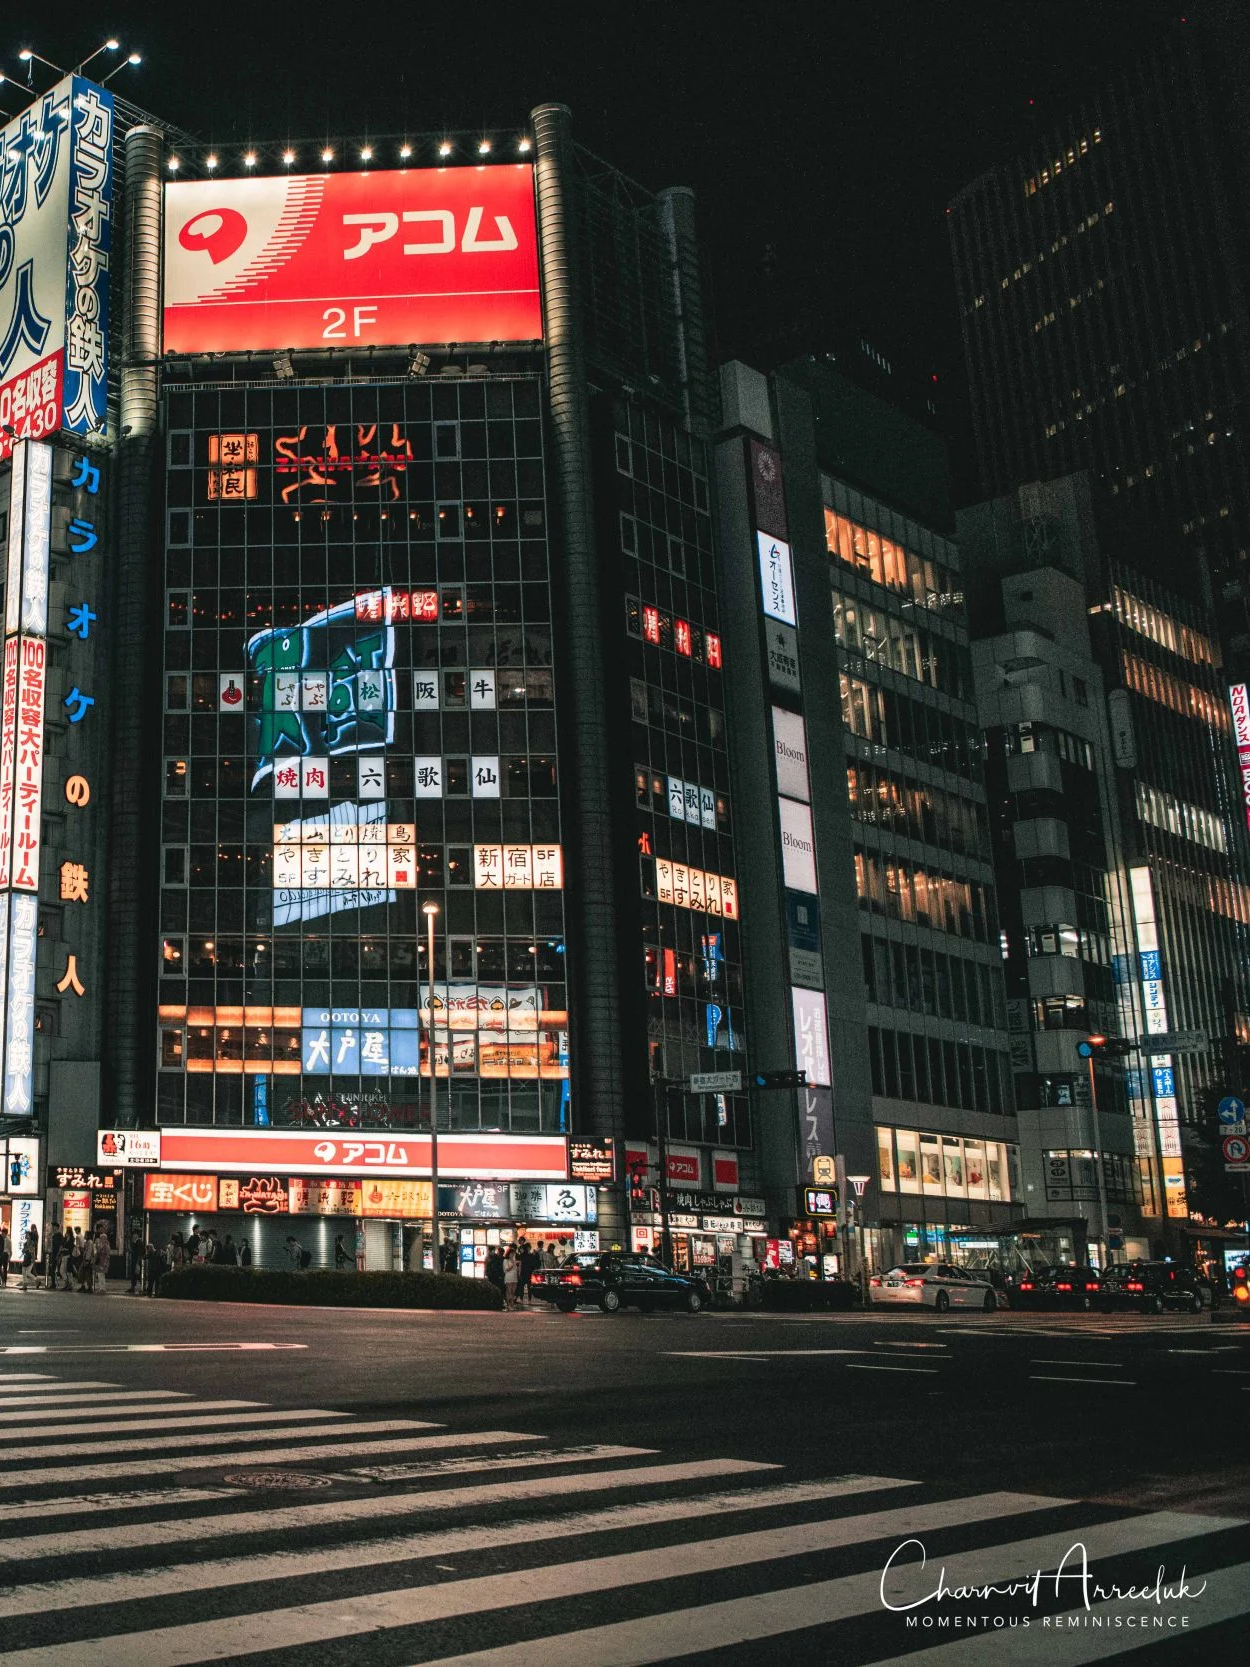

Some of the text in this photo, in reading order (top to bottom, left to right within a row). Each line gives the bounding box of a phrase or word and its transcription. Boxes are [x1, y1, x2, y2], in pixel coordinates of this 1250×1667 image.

[342, 206, 519, 261] アコム
[67, 89, 113, 434] カラオケの鉄人
[322, 306, 378, 339] 2F
[1231, 685, 1250, 744] NOAダンス
[776, 740, 806, 763] Bloom
[15, 640, 45, 888] 100名収容大パーティールーム
[276, 768, 498, 790] 焼肉 六歌仙
[669, 783, 715, 813] 六歌仙
[782, 831, 813, 853] Bloom
[478, 846, 527, 869] 新宿
[6, 895, 35, 1111] カラオケの鉄人
[320, 1012, 381, 1024] OOTOYA
[305, 1029, 389, 1071] 大戸屋
[342, 1143, 408, 1165] アコム
[570, 1148, 605, 1159] すみれ
[676, 1162, 694, 1175] アコム
[56, 1173, 103, 1188] すみれ
[150, 1181, 213, 1203] 宝くじ
[67, 1200, 86, 1209] アコム
[458, 1183, 508, 1212] 大戸屋 3F
